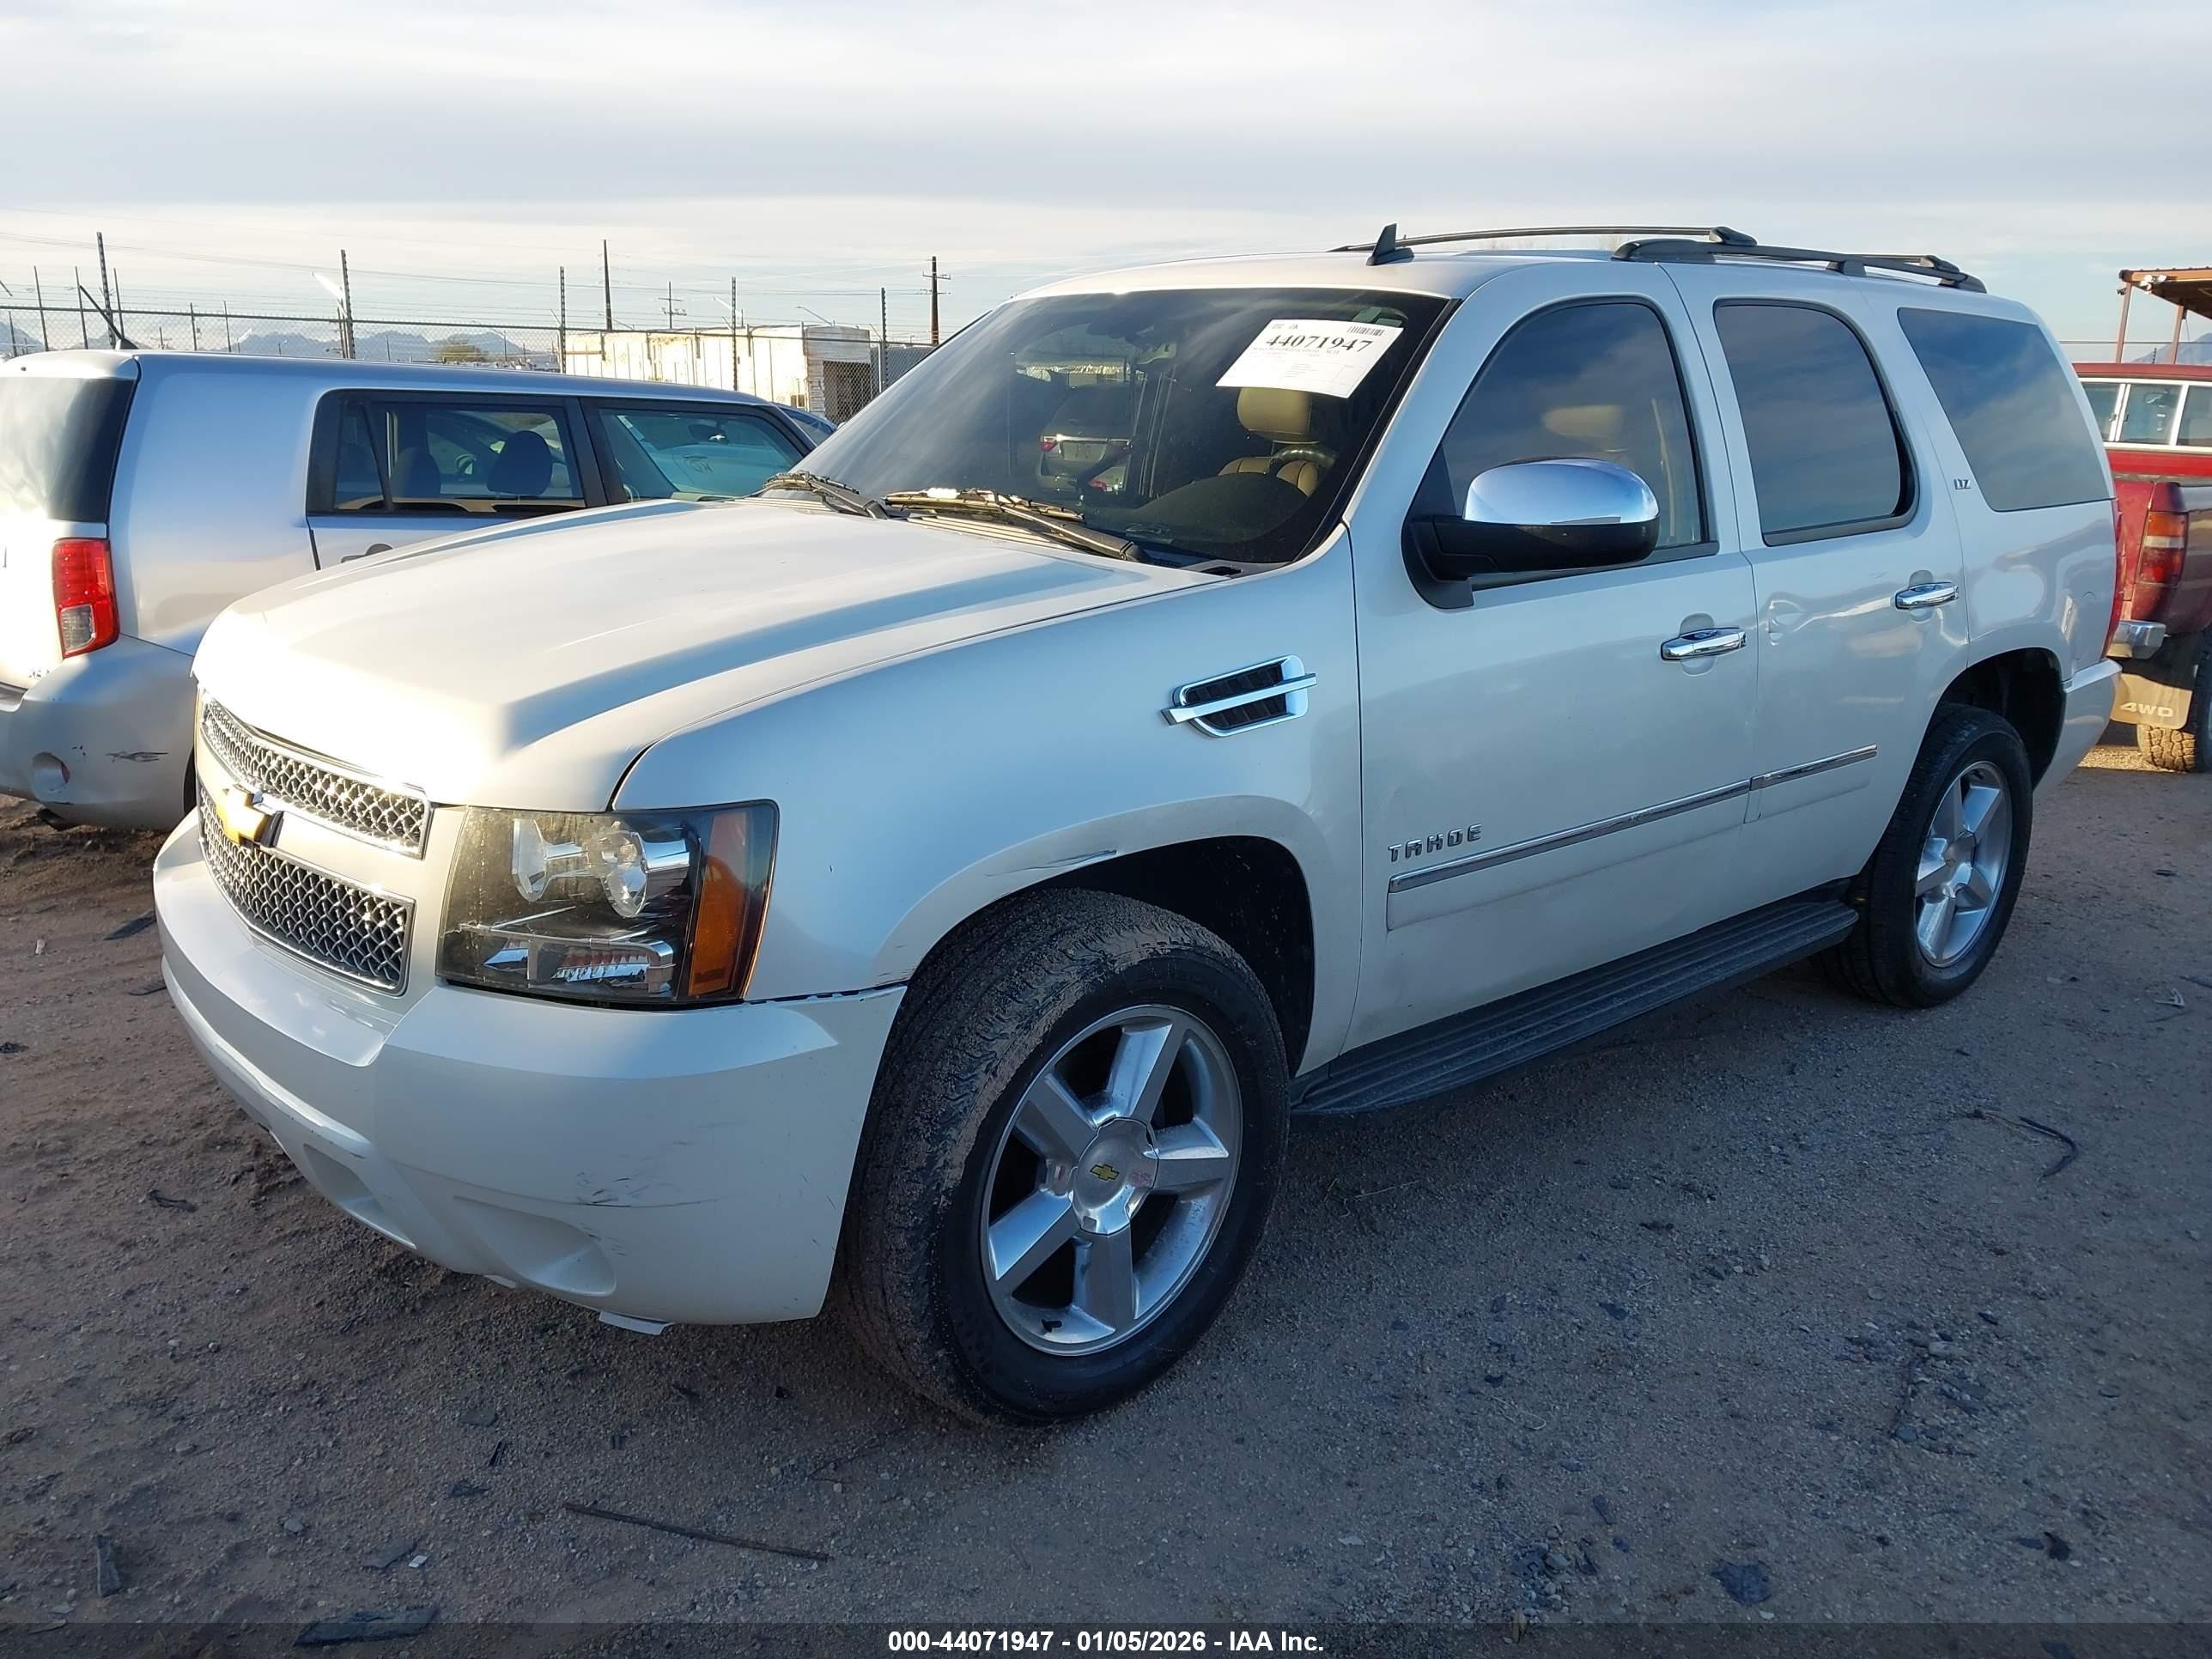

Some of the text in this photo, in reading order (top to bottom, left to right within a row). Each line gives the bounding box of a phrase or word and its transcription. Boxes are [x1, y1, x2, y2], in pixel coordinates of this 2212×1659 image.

[1266, 335, 1374, 352] 44071947
[2120, 702, 2173, 717] 4WD
[1388, 823, 1481, 862] TAHOE
